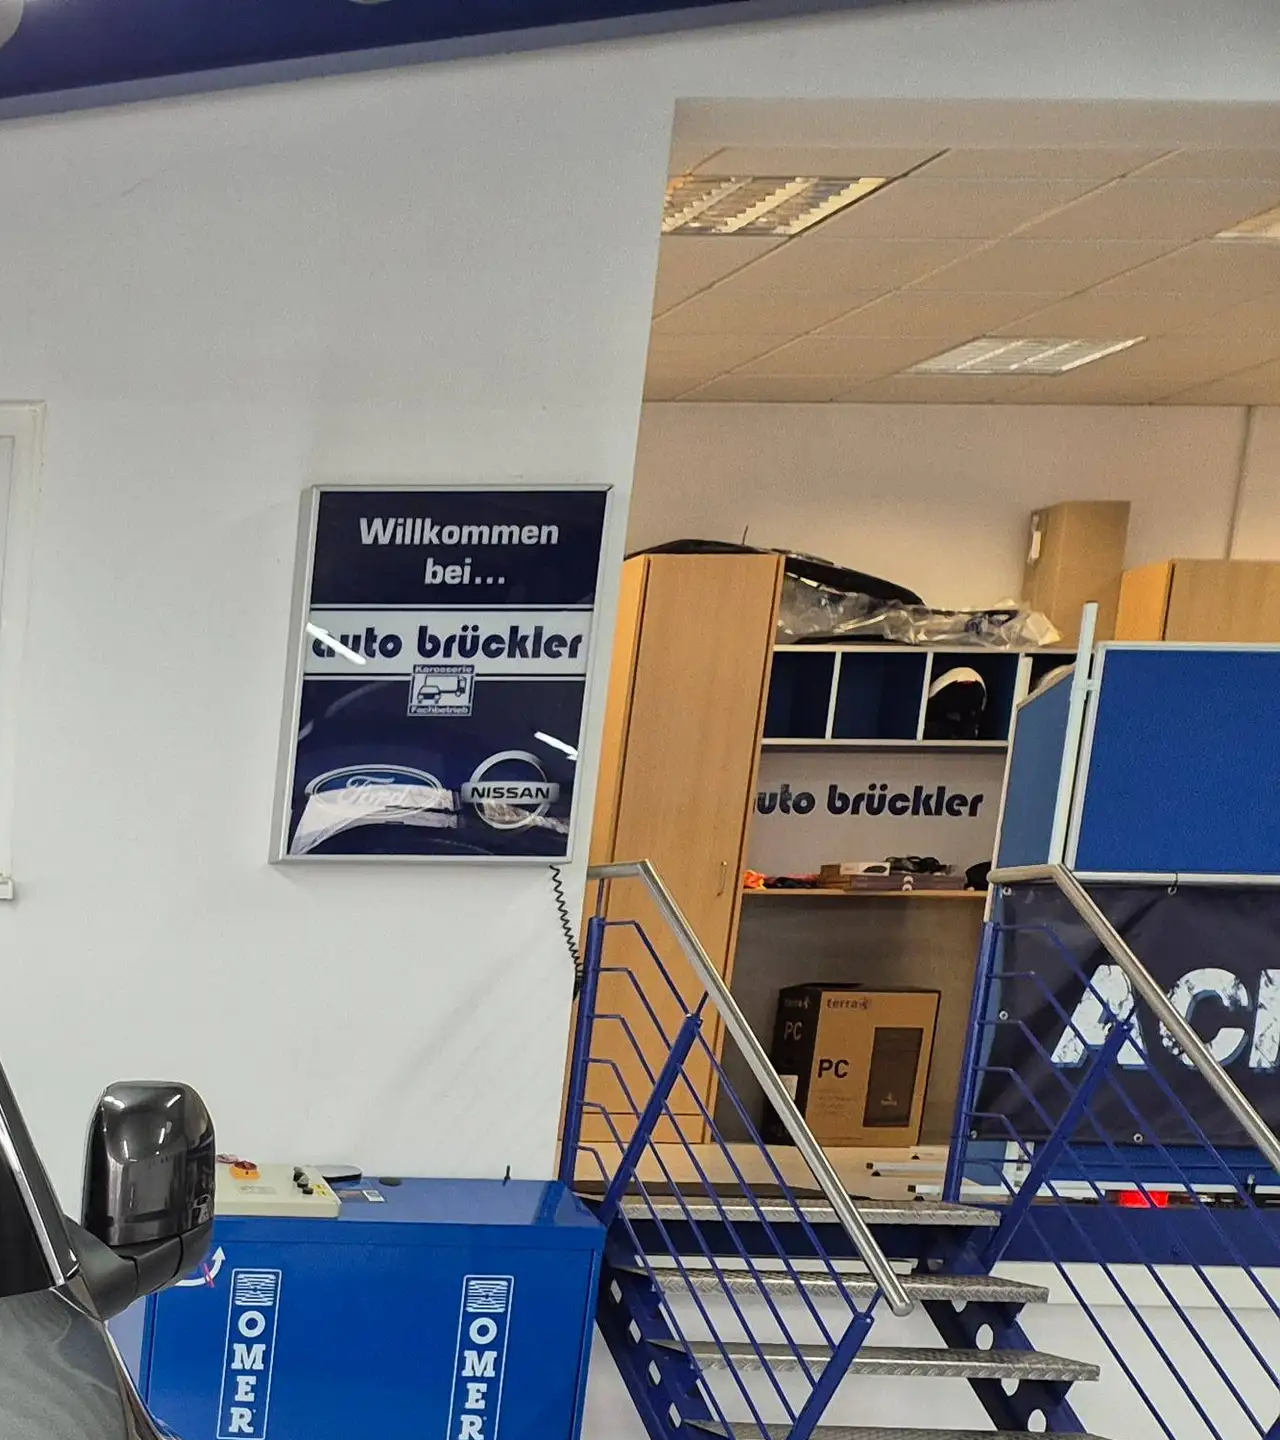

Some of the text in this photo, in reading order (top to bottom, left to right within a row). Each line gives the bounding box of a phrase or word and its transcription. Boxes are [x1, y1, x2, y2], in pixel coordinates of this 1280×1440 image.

[359, 517, 560, 546] Willkommen
[424, 557, 506, 585] bei...
[416, 624, 583, 659] brückler
[340, 775, 550, 806] Ford NISSAN
[753, 783, 984, 817] uto brückler
[783, 1020, 803, 1041] PC
[817, 1058, 850, 1079] PC
[228, 1310, 267, 1434] OMER
